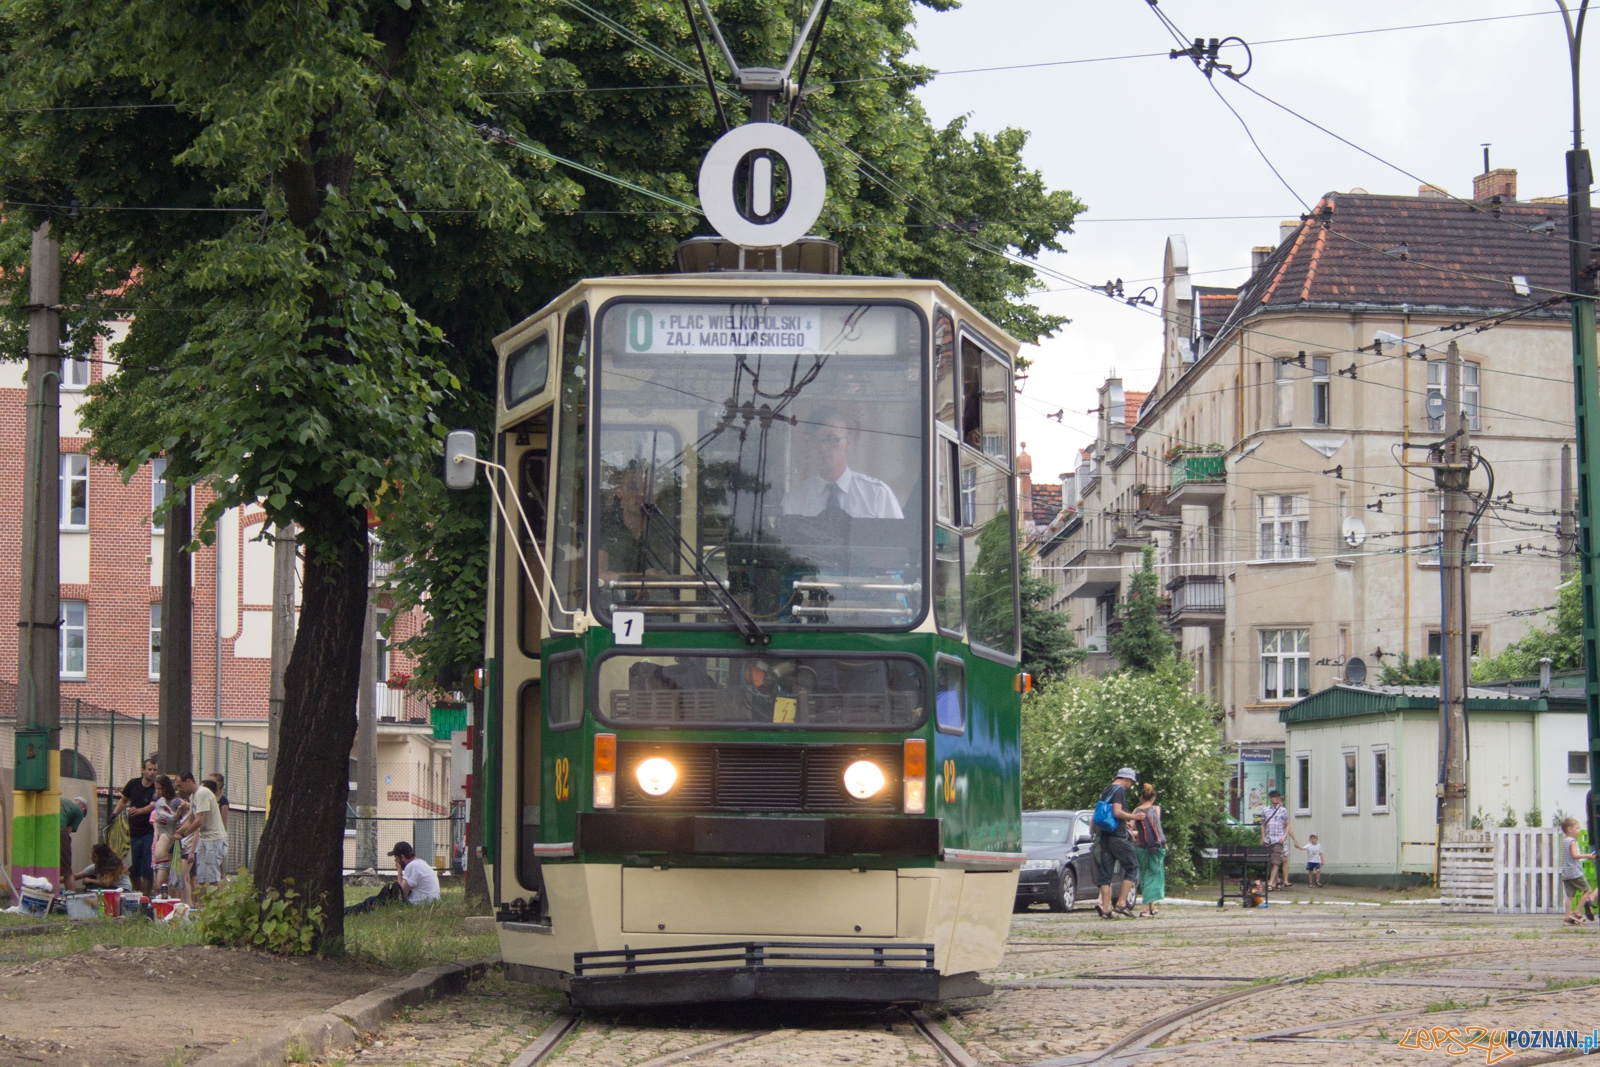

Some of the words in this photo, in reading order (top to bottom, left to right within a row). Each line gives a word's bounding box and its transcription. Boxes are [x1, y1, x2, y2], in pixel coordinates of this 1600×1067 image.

[732, 147, 792, 225] 0
[629, 308, 653, 352] 0
[666, 331, 695, 346] ZAJ.
[670, 314, 704, 330] PLAC
[708, 315, 801, 331] WIELKOPOLSKI
[624, 619, 633, 637] 1
[555, 757, 569, 802] 82
[943, 759, 956, 803] 82
